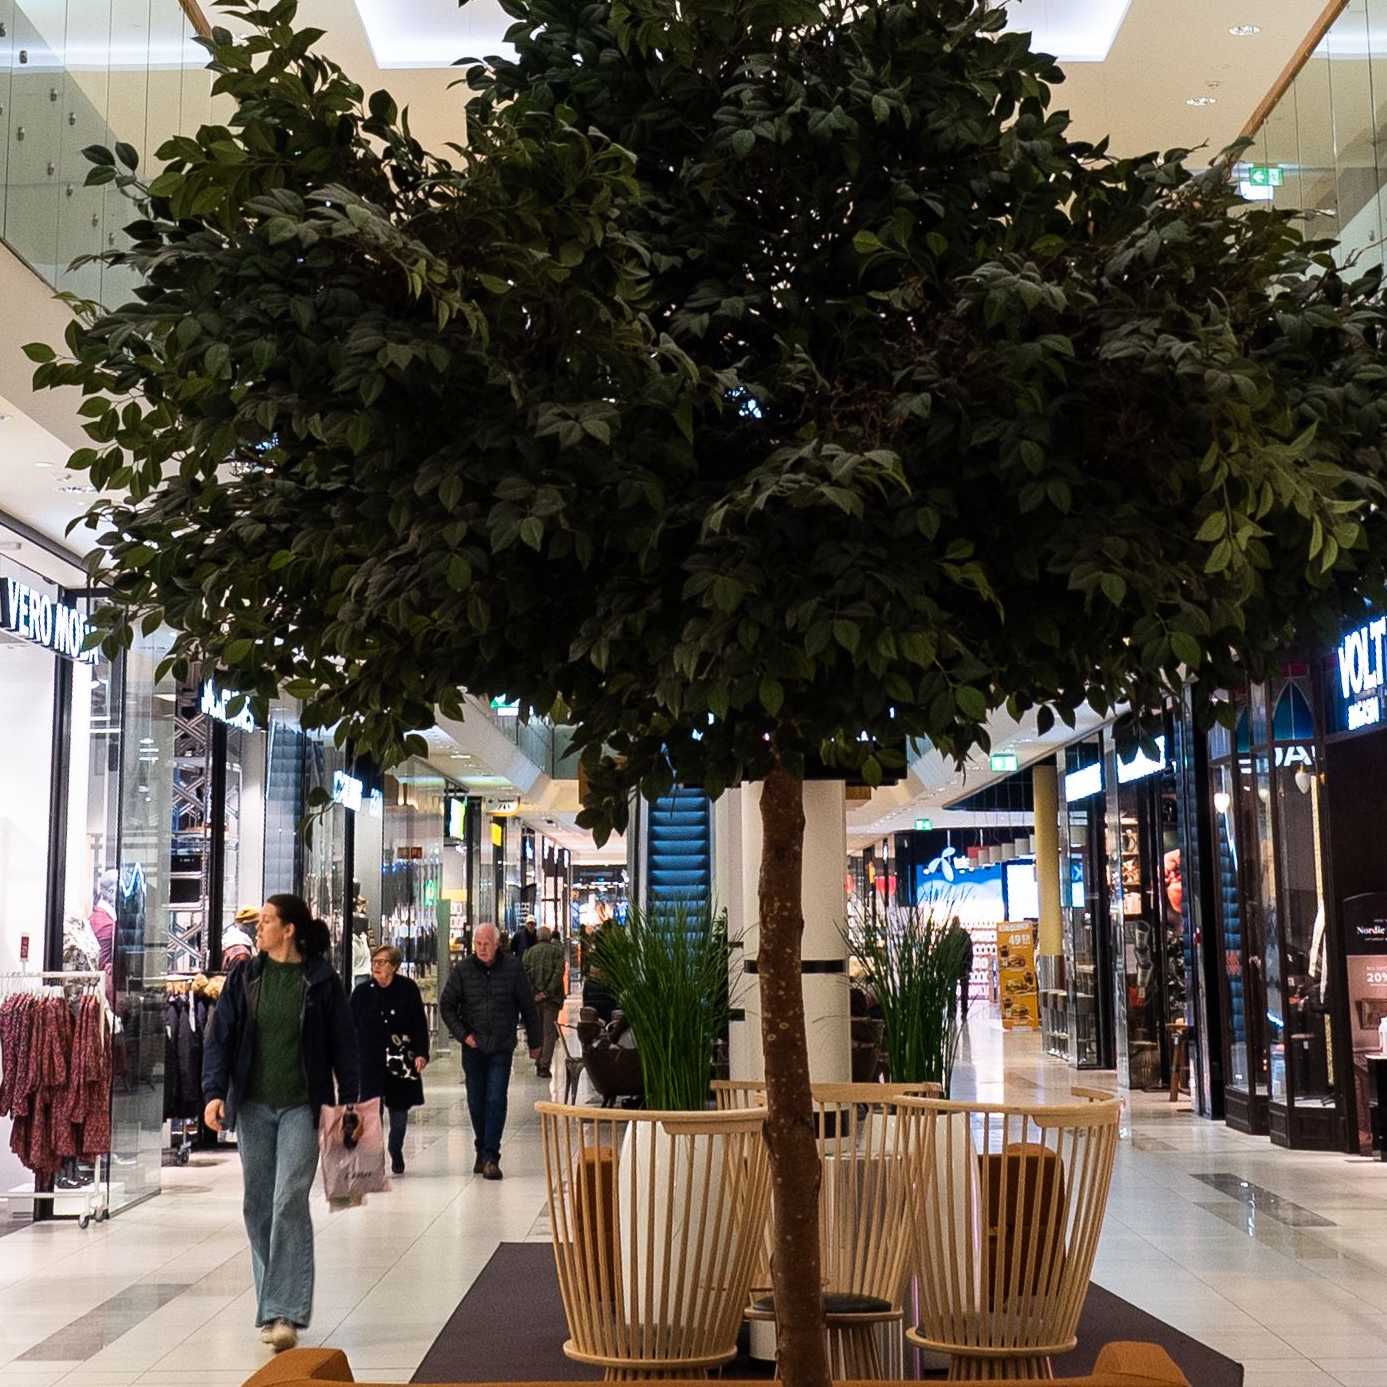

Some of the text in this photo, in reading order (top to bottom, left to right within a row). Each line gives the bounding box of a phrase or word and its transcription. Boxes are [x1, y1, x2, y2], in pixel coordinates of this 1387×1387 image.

[7, 576, 52, 646] VERO
[1337, 615, 1386, 699] VOLT
[1356, 925, 1385, 935] Nordic
